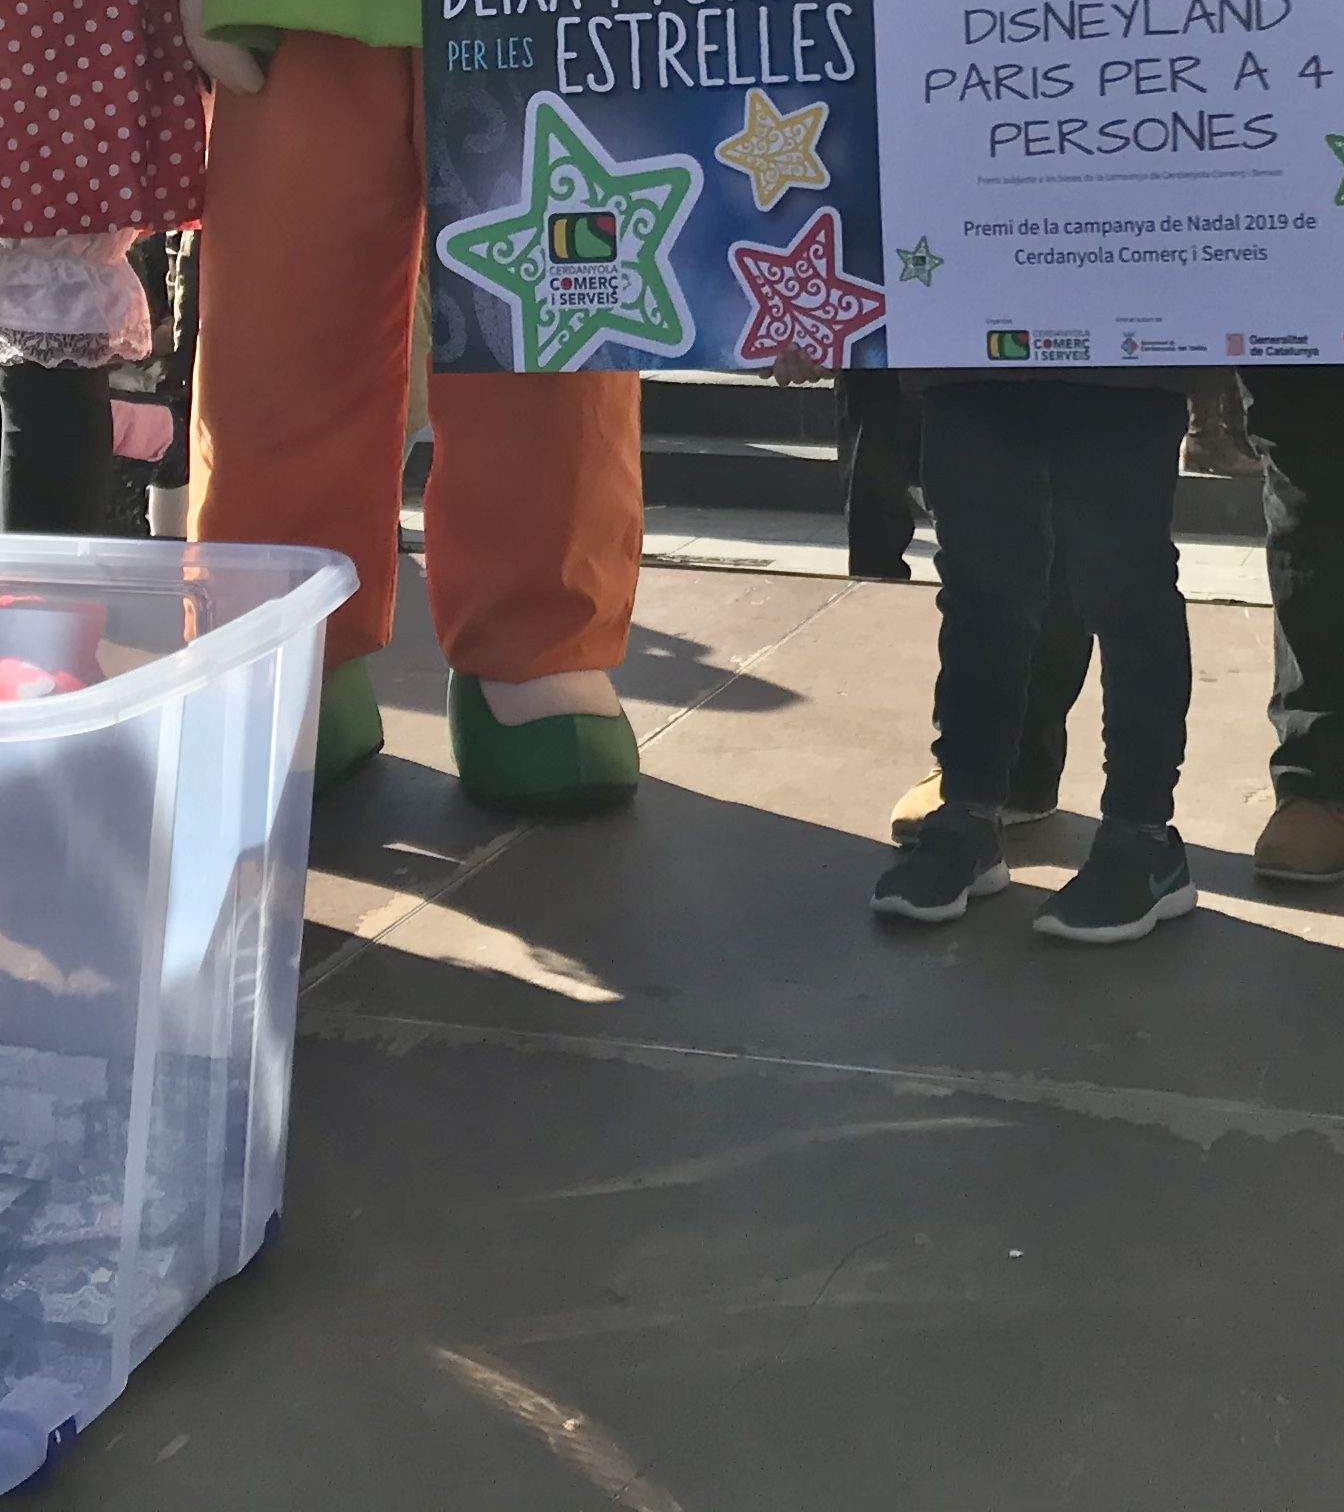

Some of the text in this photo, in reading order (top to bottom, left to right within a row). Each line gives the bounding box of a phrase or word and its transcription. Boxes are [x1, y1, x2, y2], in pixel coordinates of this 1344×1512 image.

[446, 2, 856, 94] PER LES ESTRELLES
[924, 50, 1335, 104] PARIS PER A 4
[989, 109, 1280, 159] PERSONES
[963, 212, 1318, 239] Premi de la campanya de Nadal 2019 de
[1014, 244, 1269, 269] Cerdanyola Comerç i Serveis
[559, 292, 619, 306] SERVEIS
